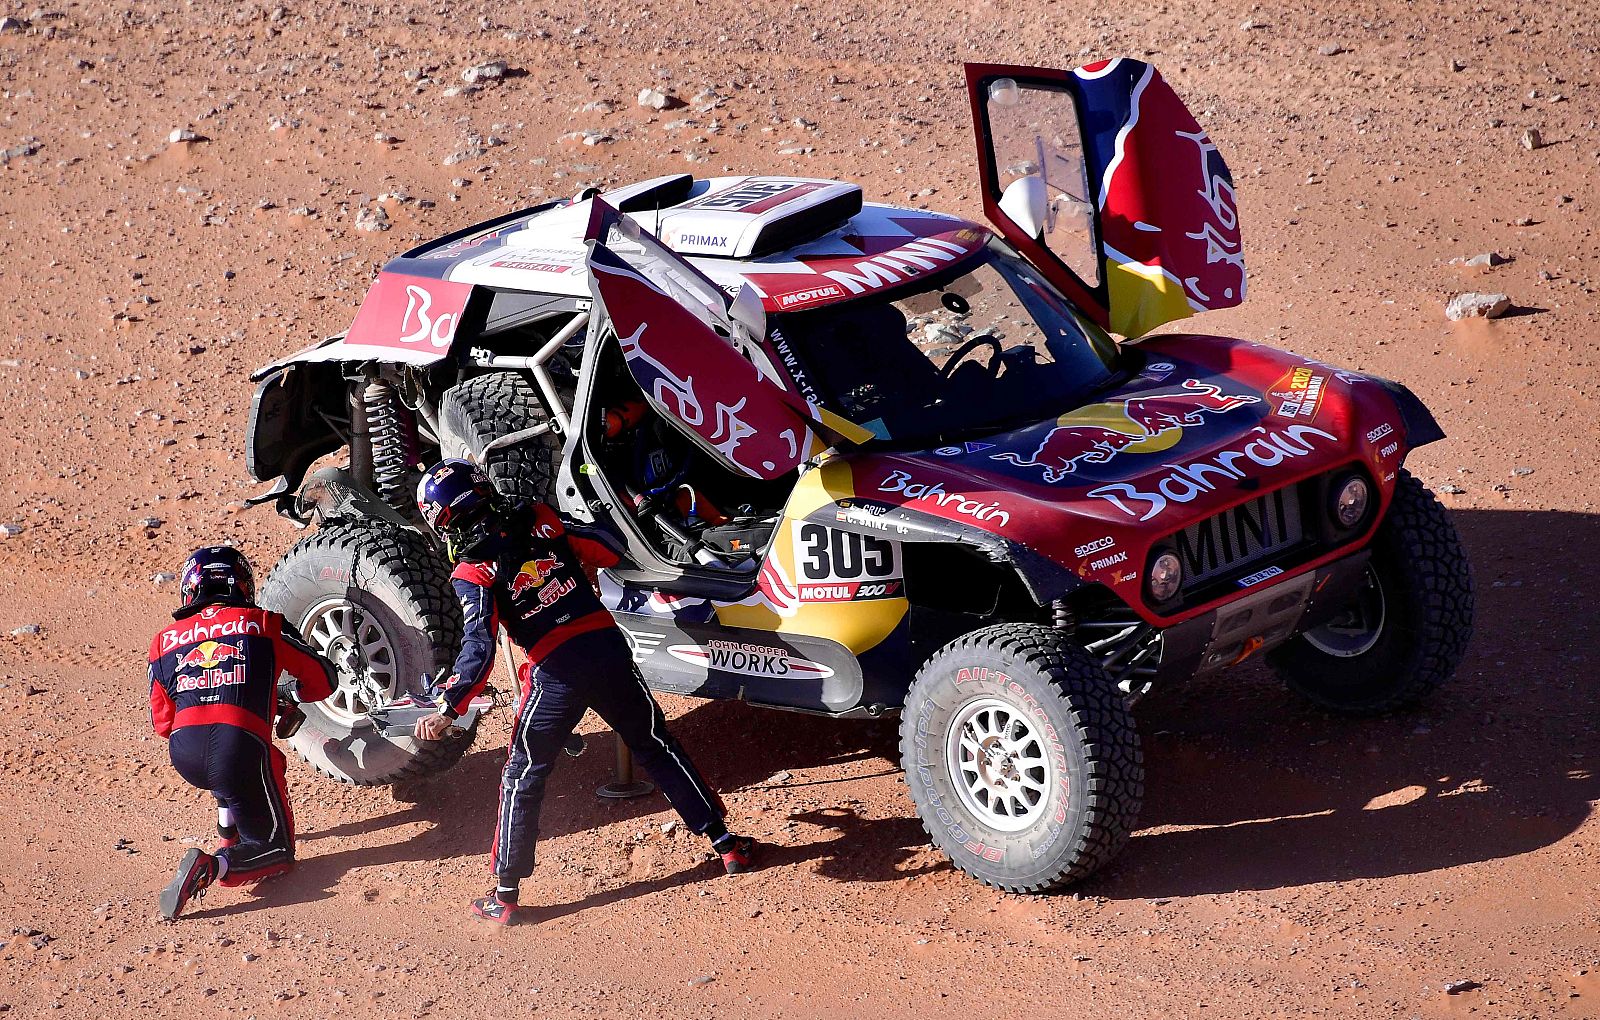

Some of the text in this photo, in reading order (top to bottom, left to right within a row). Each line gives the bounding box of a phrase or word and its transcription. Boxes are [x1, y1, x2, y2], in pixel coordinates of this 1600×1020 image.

[680, 234, 728, 248] PRIMAX
[822, 237, 969, 295] MINI
[782, 285, 841, 306] MOTUL
[1291, 367, 1313, 389] 2020
[1366, 422, 1393, 443] sparco
[1087, 423, 1338, 522] Bahrain
[878, 470, 1010, 528] Bahrain
[1074, 535, 1116, 558] sparco
[1174, 489, 1288, 577] MINI
[801, 523, 894, 580] 305
[1090, 550, 1128, 571] PRIMAX
[800, 581, 902, 600] MOTUL 300V
[162, 615, 260, 653] Bahrain
[708, 639, 788, 658] JOHN COOPER
[710, 648, 789, 675] WORKS
[176, 663, 246, 693] Red Bull
[955, 665, 1068, 774] All-Terrain
